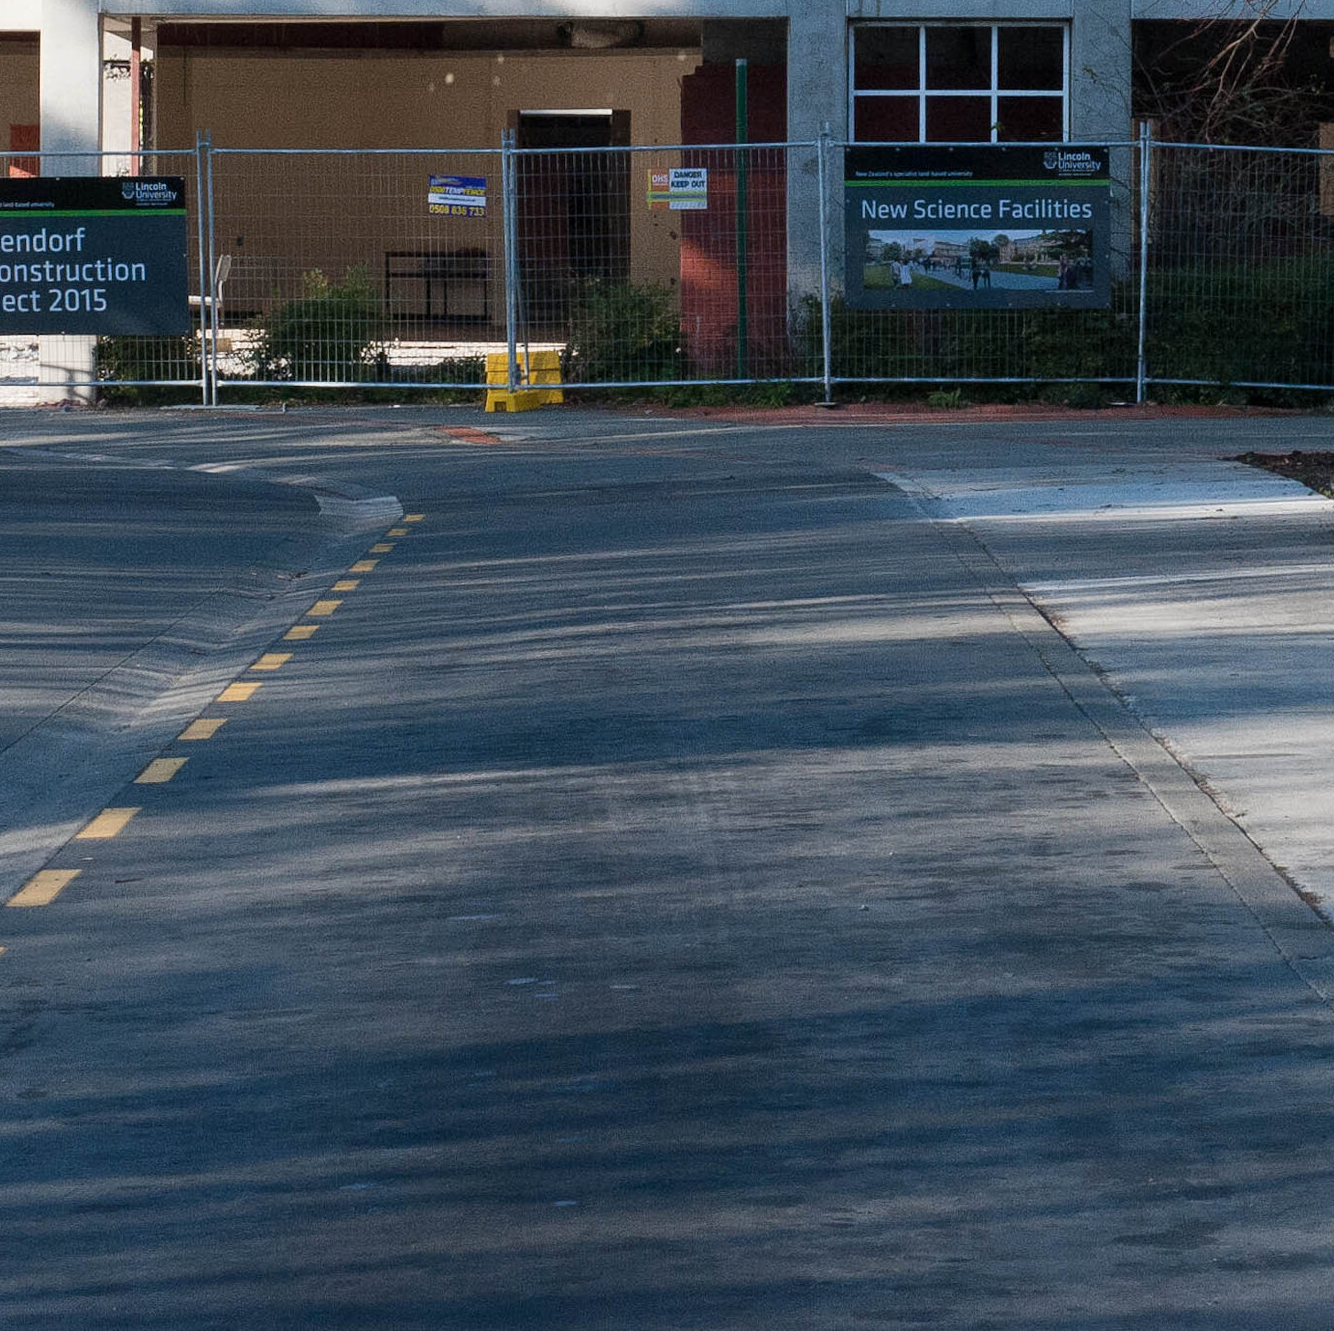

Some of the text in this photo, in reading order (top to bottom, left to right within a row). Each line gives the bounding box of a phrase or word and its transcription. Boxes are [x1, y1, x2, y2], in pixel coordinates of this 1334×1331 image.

[1058, 152, 1091, 161] Lincoln
[1058, 161, 1101, 170] University
[674, 171, 703, 179] DANGER
[135, 182, 167, 191] Lincoln
[671, 180, 706, 188] KEEP OUT
[136, 191, 178, 201] University
[429, 204, 485, 216] 0508 836 733
[862, 199, 1092, 219] New Science Facilities
[49, 288, 107, 312] 2015
